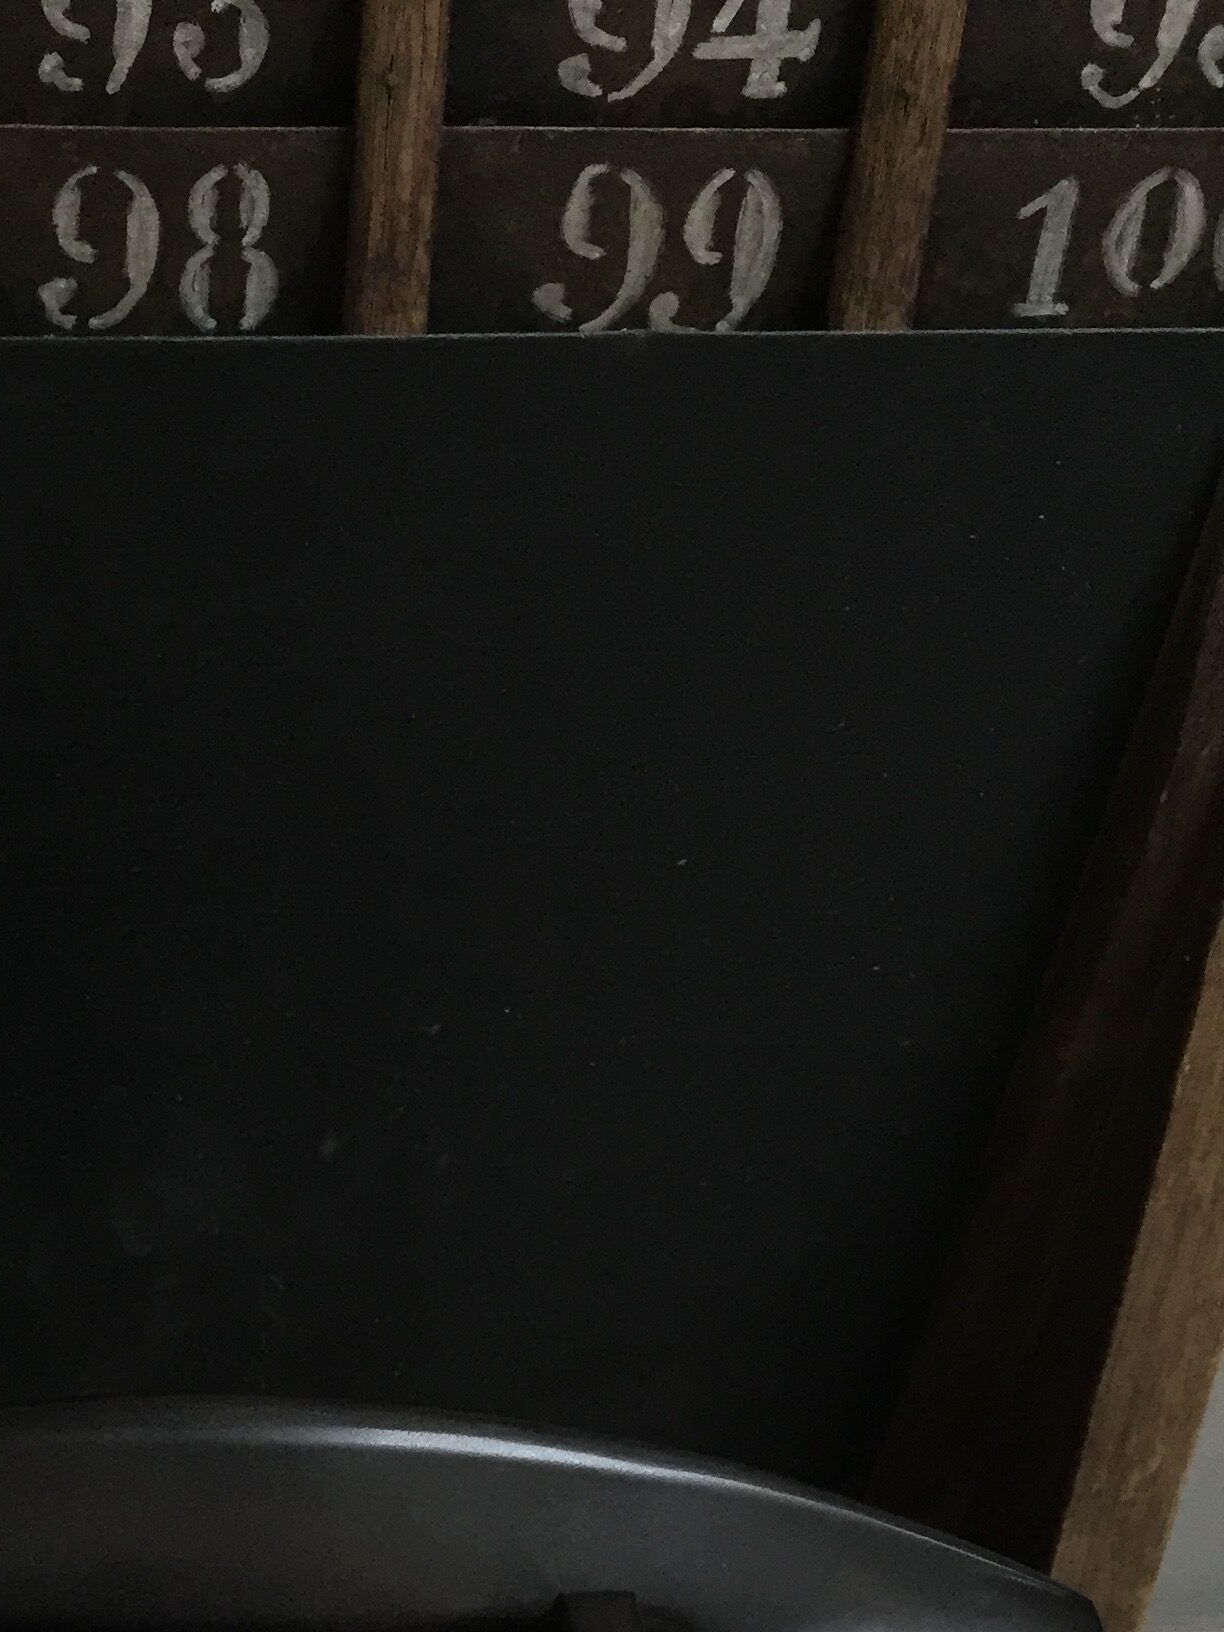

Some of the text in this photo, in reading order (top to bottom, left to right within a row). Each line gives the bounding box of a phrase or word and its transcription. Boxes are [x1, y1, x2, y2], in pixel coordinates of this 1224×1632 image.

[1081, 0, 1224, 109] 9
[38, 162, 278, 331] 98
[532, 163, 783, 337] 99
[1010, 166, 1224, 318] 10
